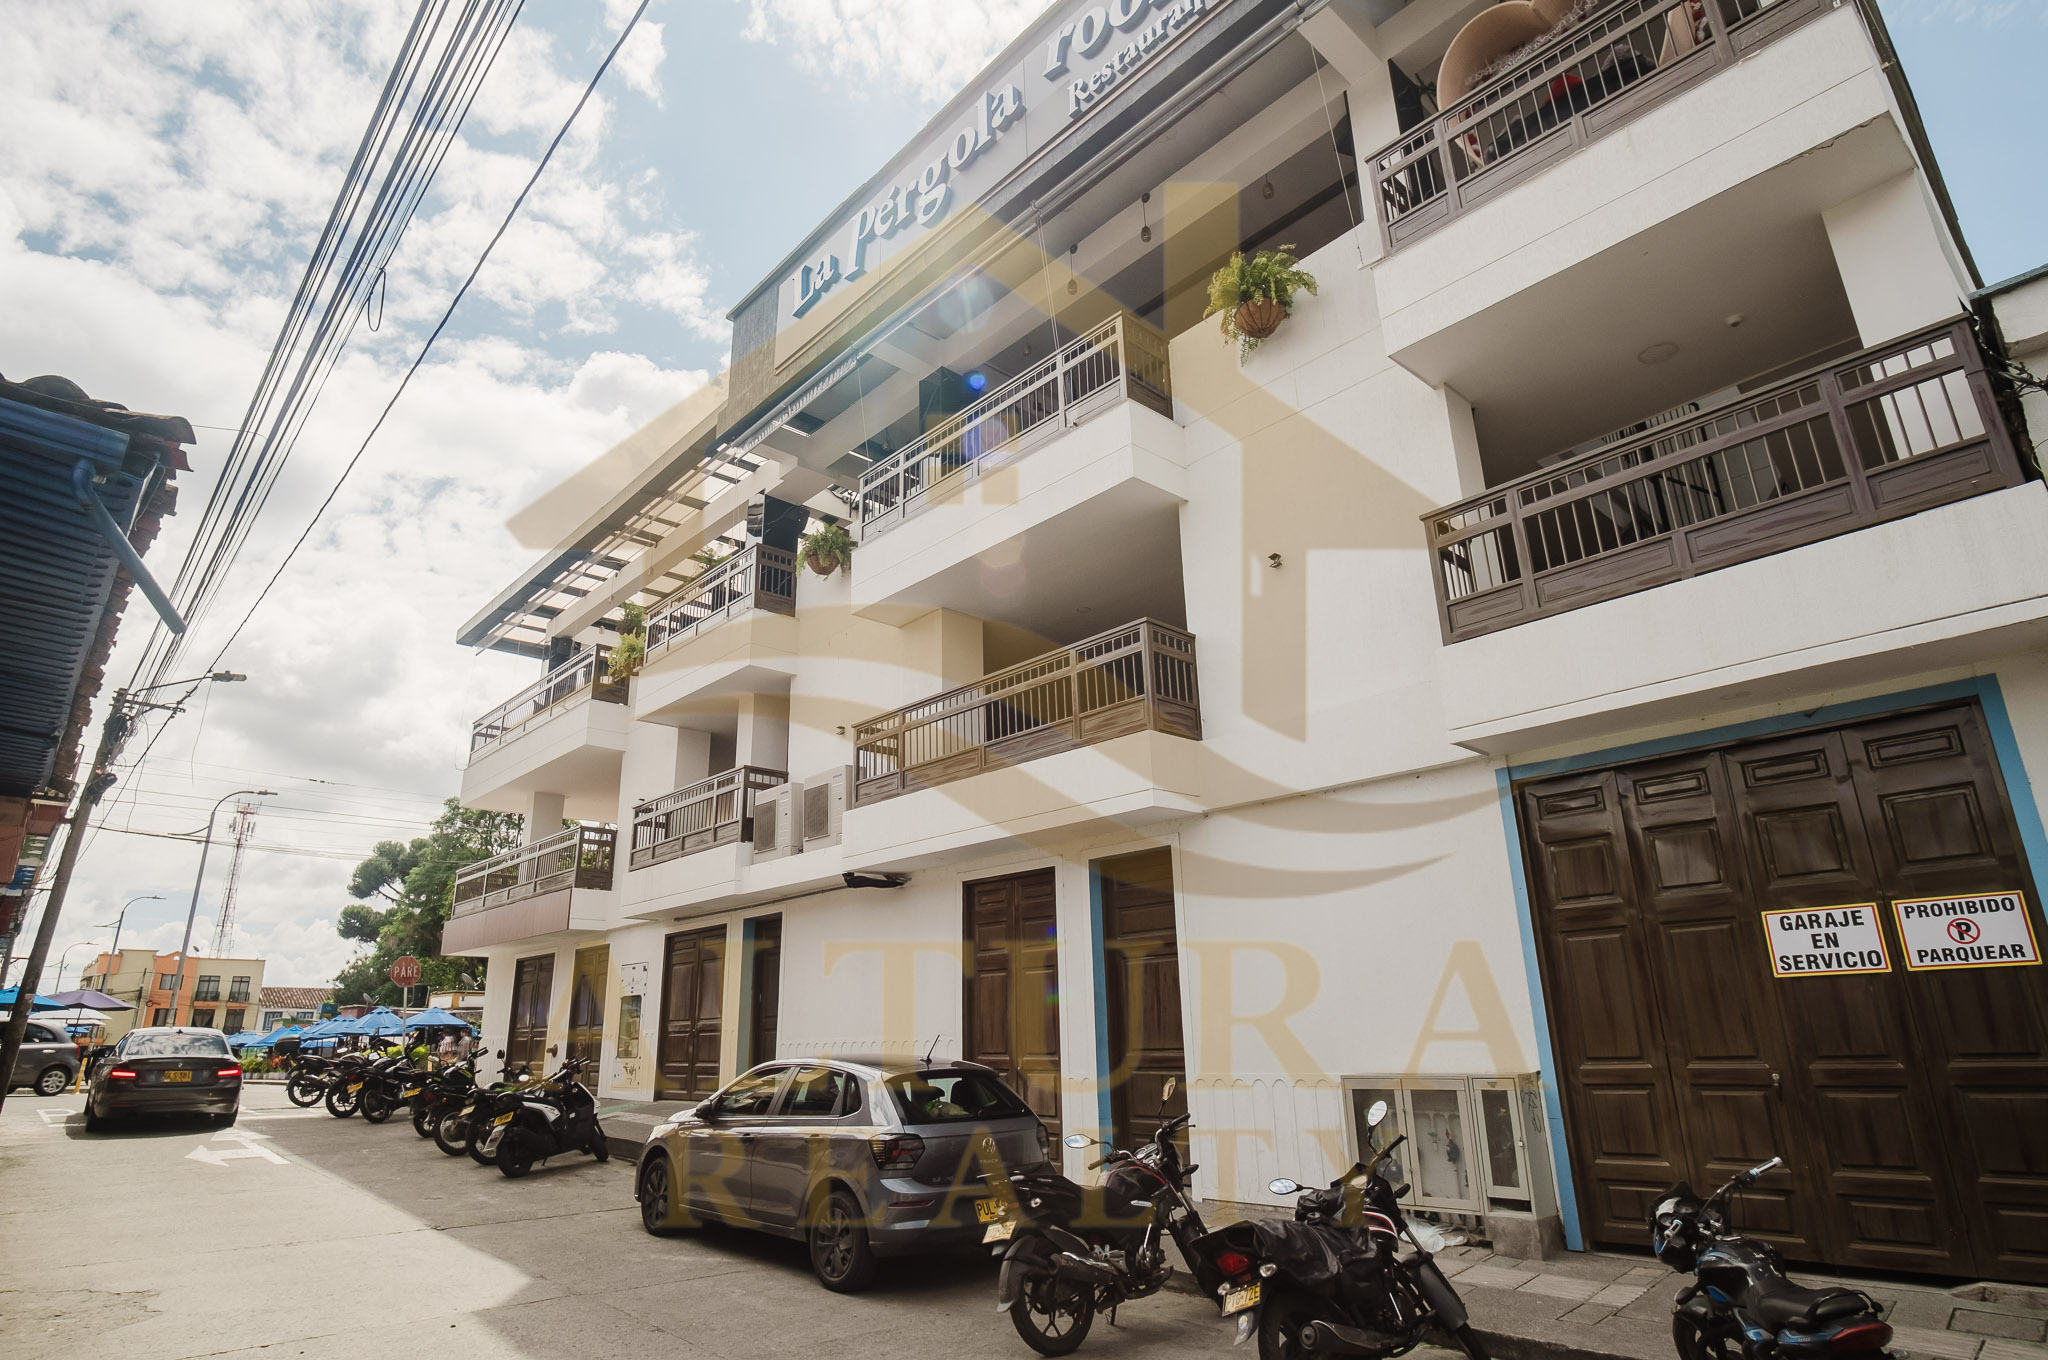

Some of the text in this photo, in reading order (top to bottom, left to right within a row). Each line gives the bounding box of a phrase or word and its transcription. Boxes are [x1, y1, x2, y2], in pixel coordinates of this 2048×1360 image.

[792, 252, 840, 318] La
[1043, 0, 1162, 81] roo
[1903, 897, 2016, 919] PROHIBIDO
[1779, 909, 1865, 931] GARAJE
[1810, 932, 1840, 949] EN
[1779, 950, 1883, 972] SERVICIO
[1917, 943, 2027, 963] PARQUEAR
[393, 965, 419, 978] PARE
